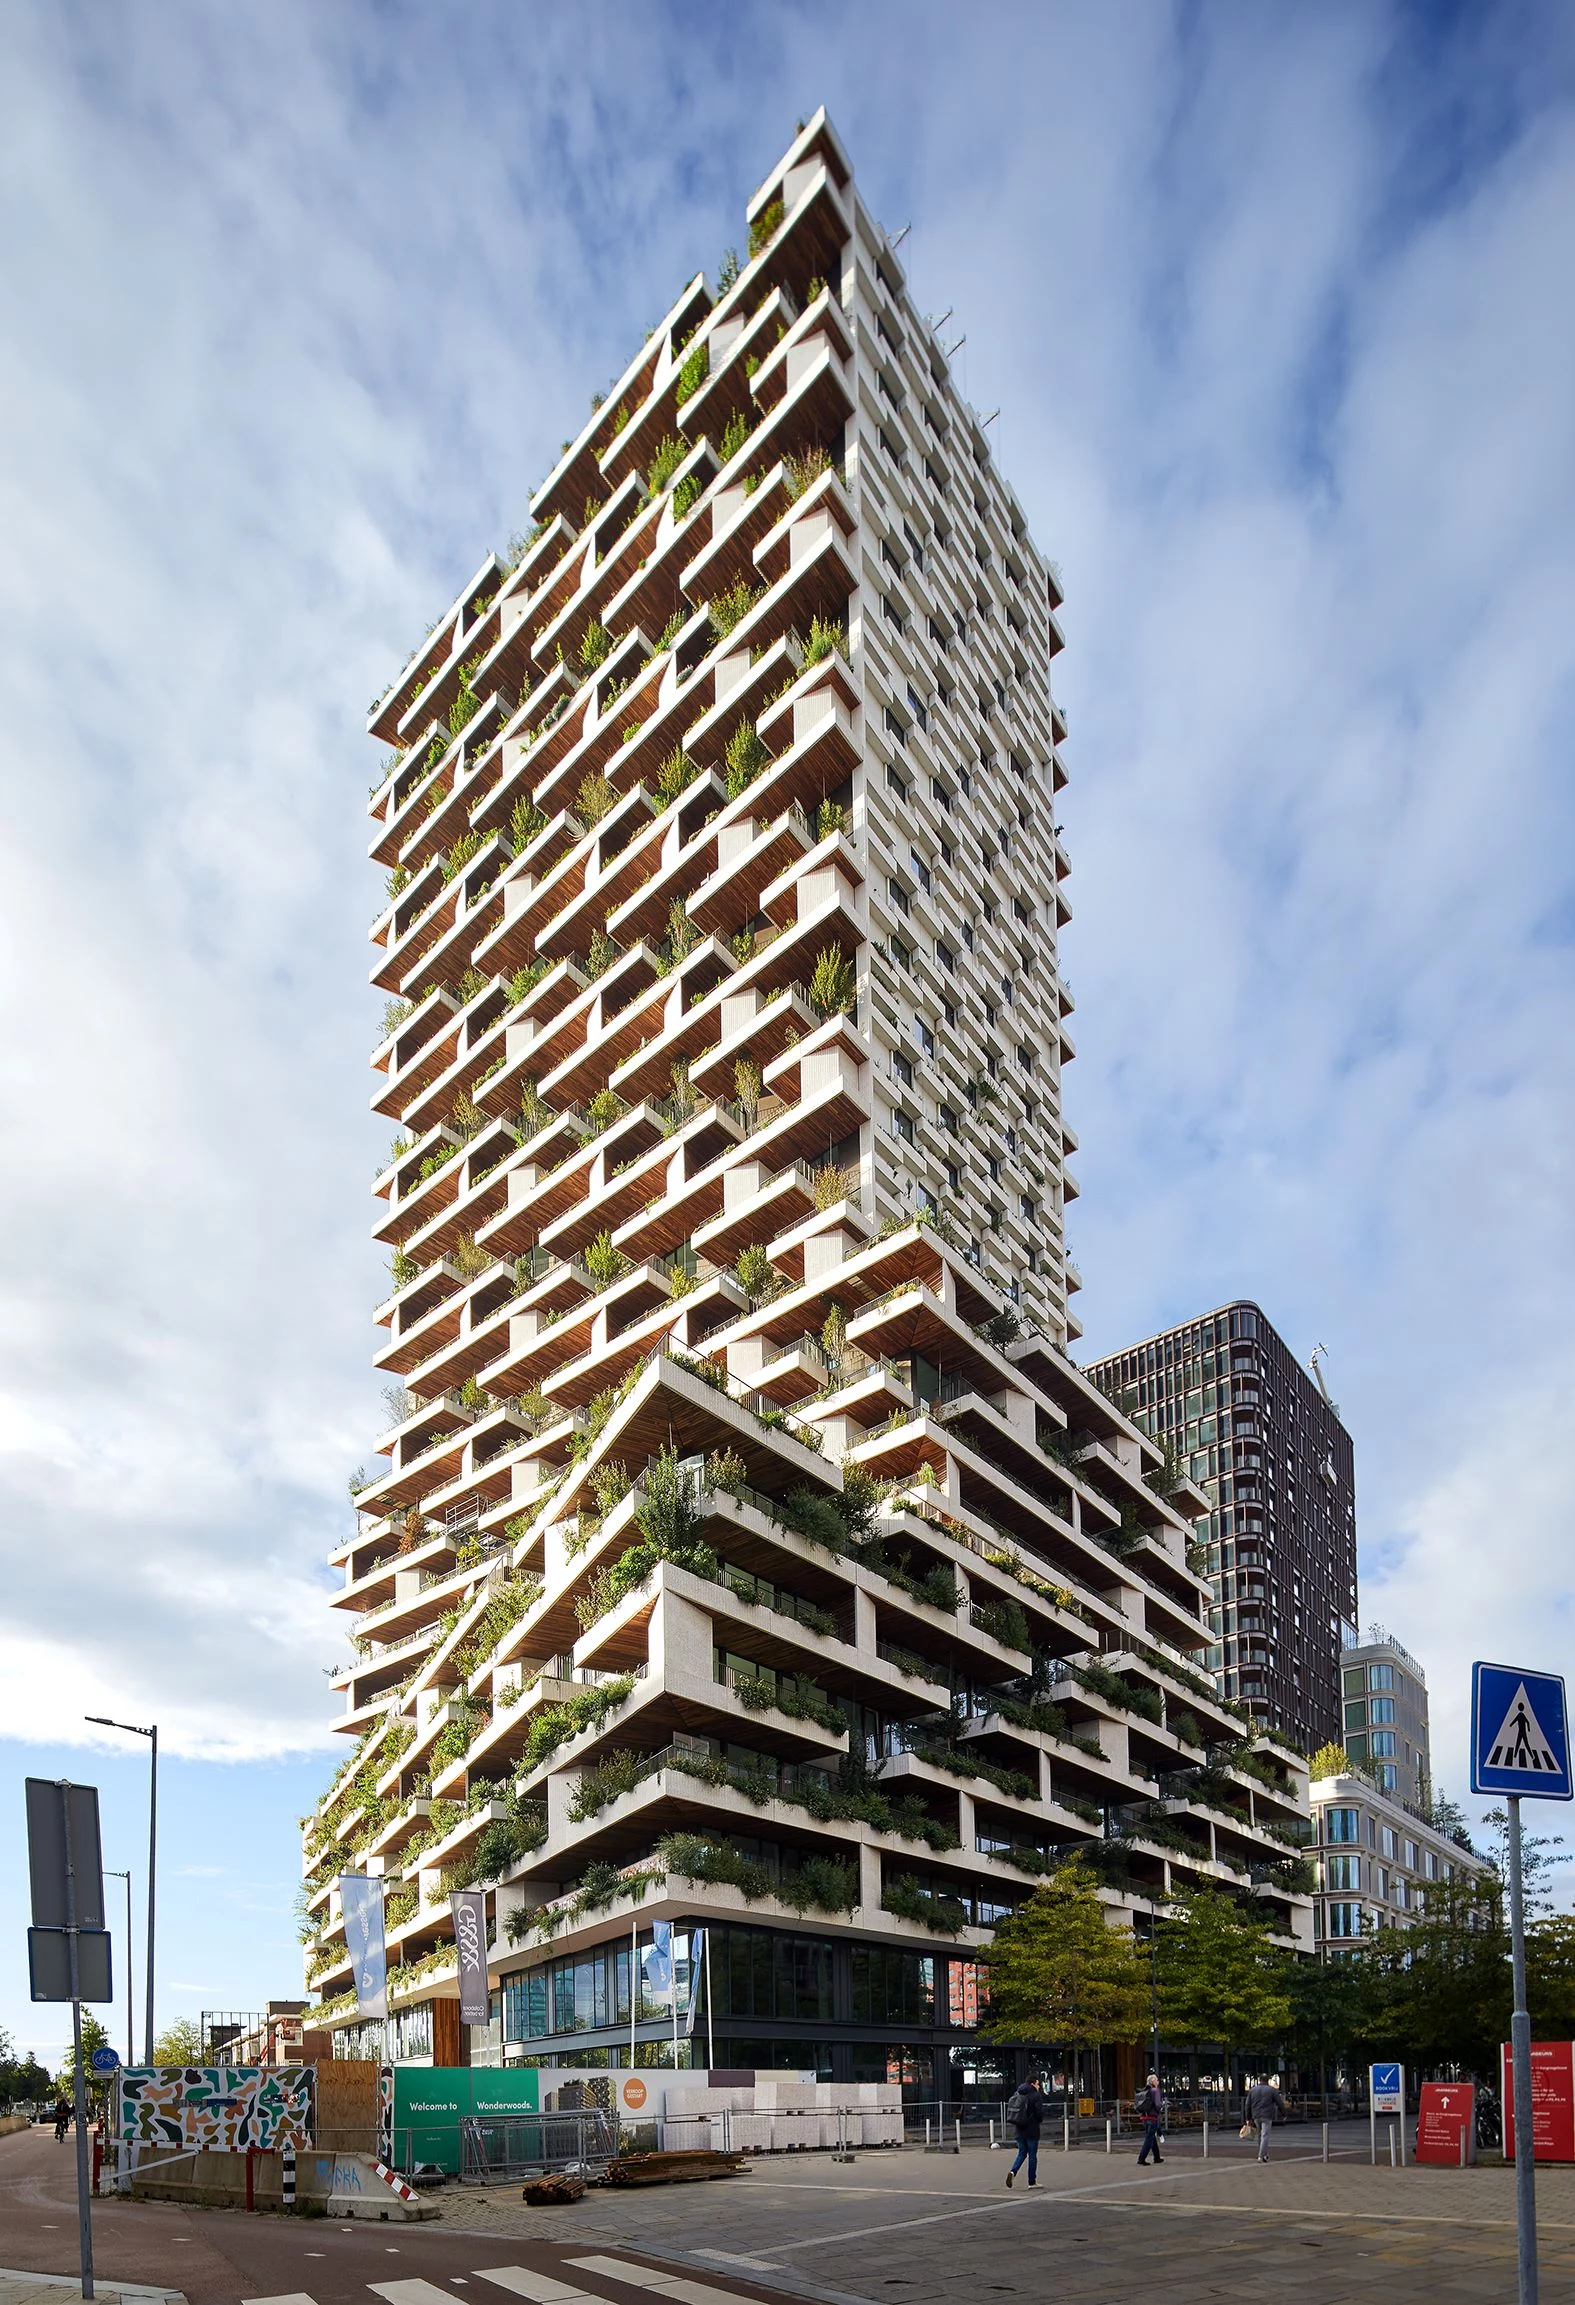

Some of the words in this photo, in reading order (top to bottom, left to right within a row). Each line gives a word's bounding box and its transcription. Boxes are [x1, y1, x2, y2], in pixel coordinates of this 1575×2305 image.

[409, 2102, 448, 2111] Welcome
[449, 2102, 458, 2110] to
[476, 2100, 533, 2110] Wonderwoods.
